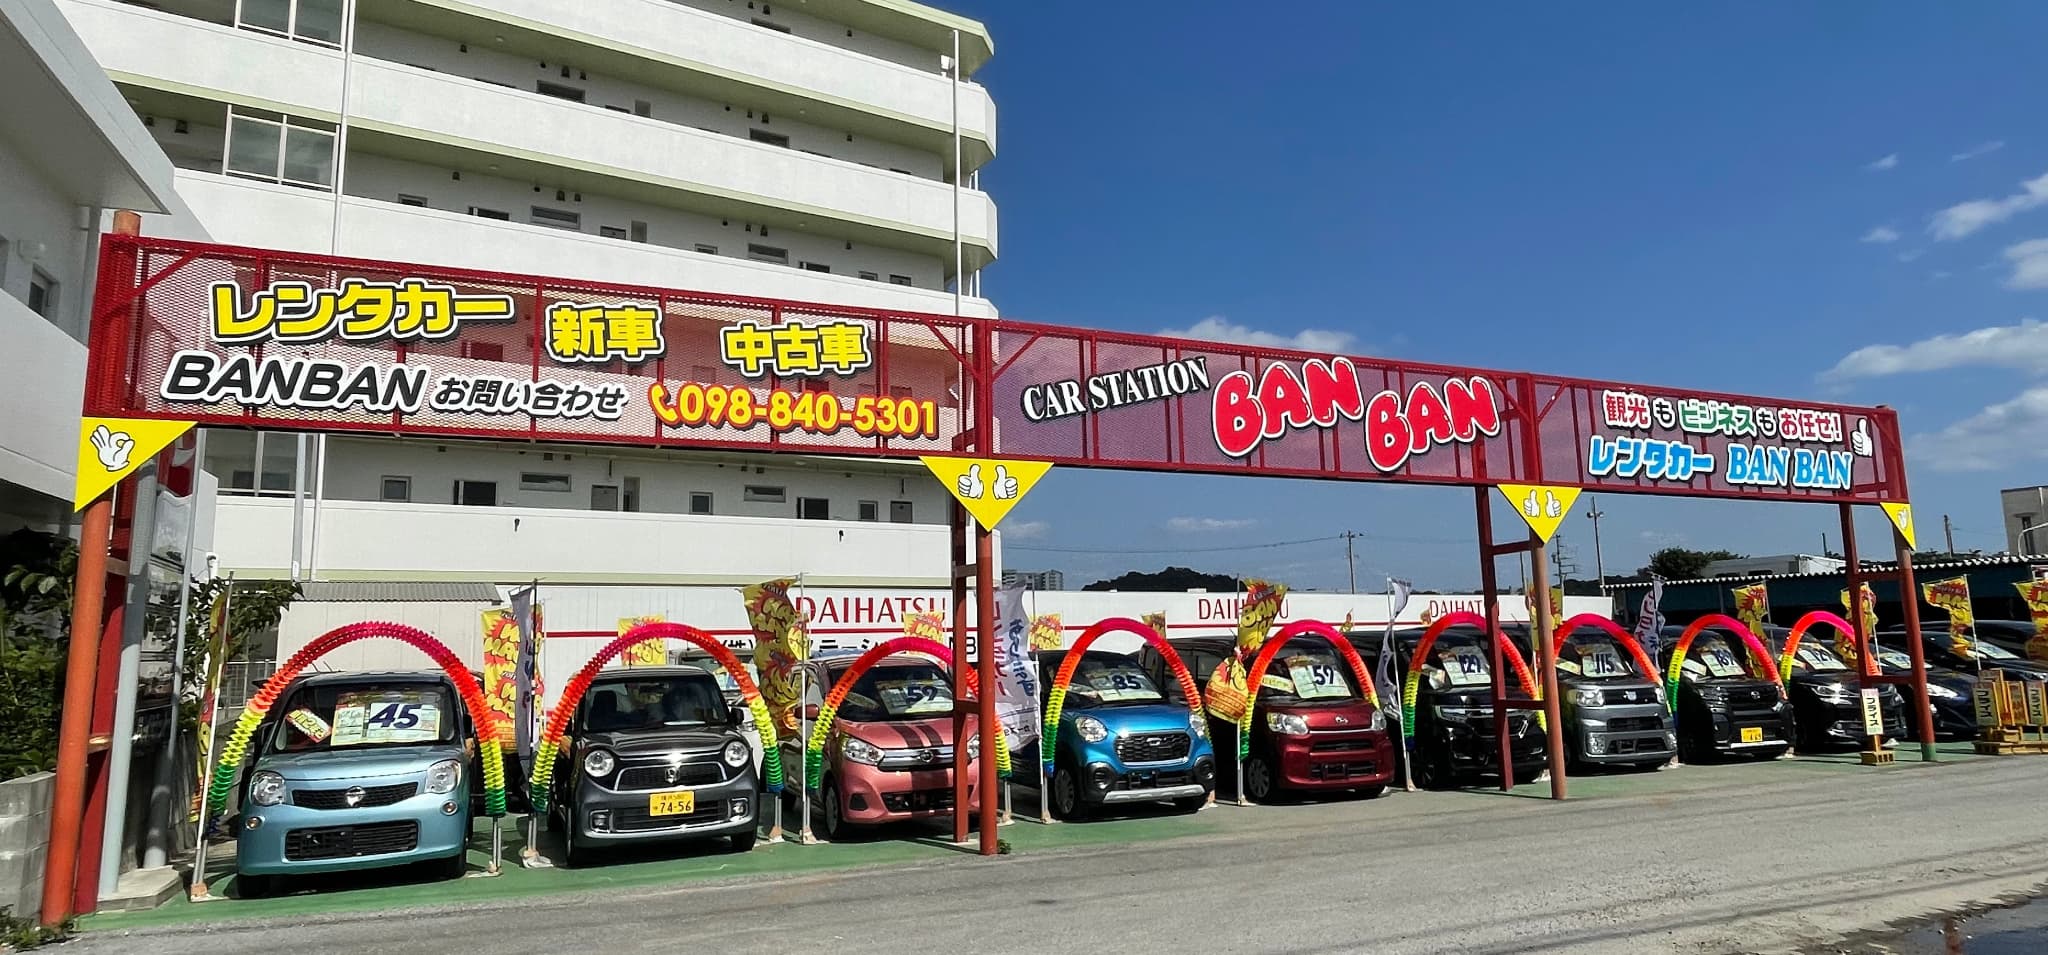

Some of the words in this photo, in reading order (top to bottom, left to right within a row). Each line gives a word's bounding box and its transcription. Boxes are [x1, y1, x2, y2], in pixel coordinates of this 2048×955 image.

[211, 281, 512, 340] レンタカー
[548, 304, 661, 361] 新車
[722, 321, 869, 375] 中古車
[164, 352, 428, 410] BANBAN
[433, 376, 627, 420] お問い合わせ
[678, 384, 937, 437] 098-840-5301
[1023, 380, 1087, 420] CAR
[1088, 357, 1211, 409] STATION
[1213, 357, 1363, 457] BAN
[1366, 375, 1500, 472] BAN
[1590, 436, 1714, 480] レンタカー
[1727, 444, 1789, 487] BAN
[1793, 449, 1852, 490] BAN
[1112, 674, 1141, 690] 85
[1312, 664, 1334, 686] 59
[369, 703, 421, 729] 45
